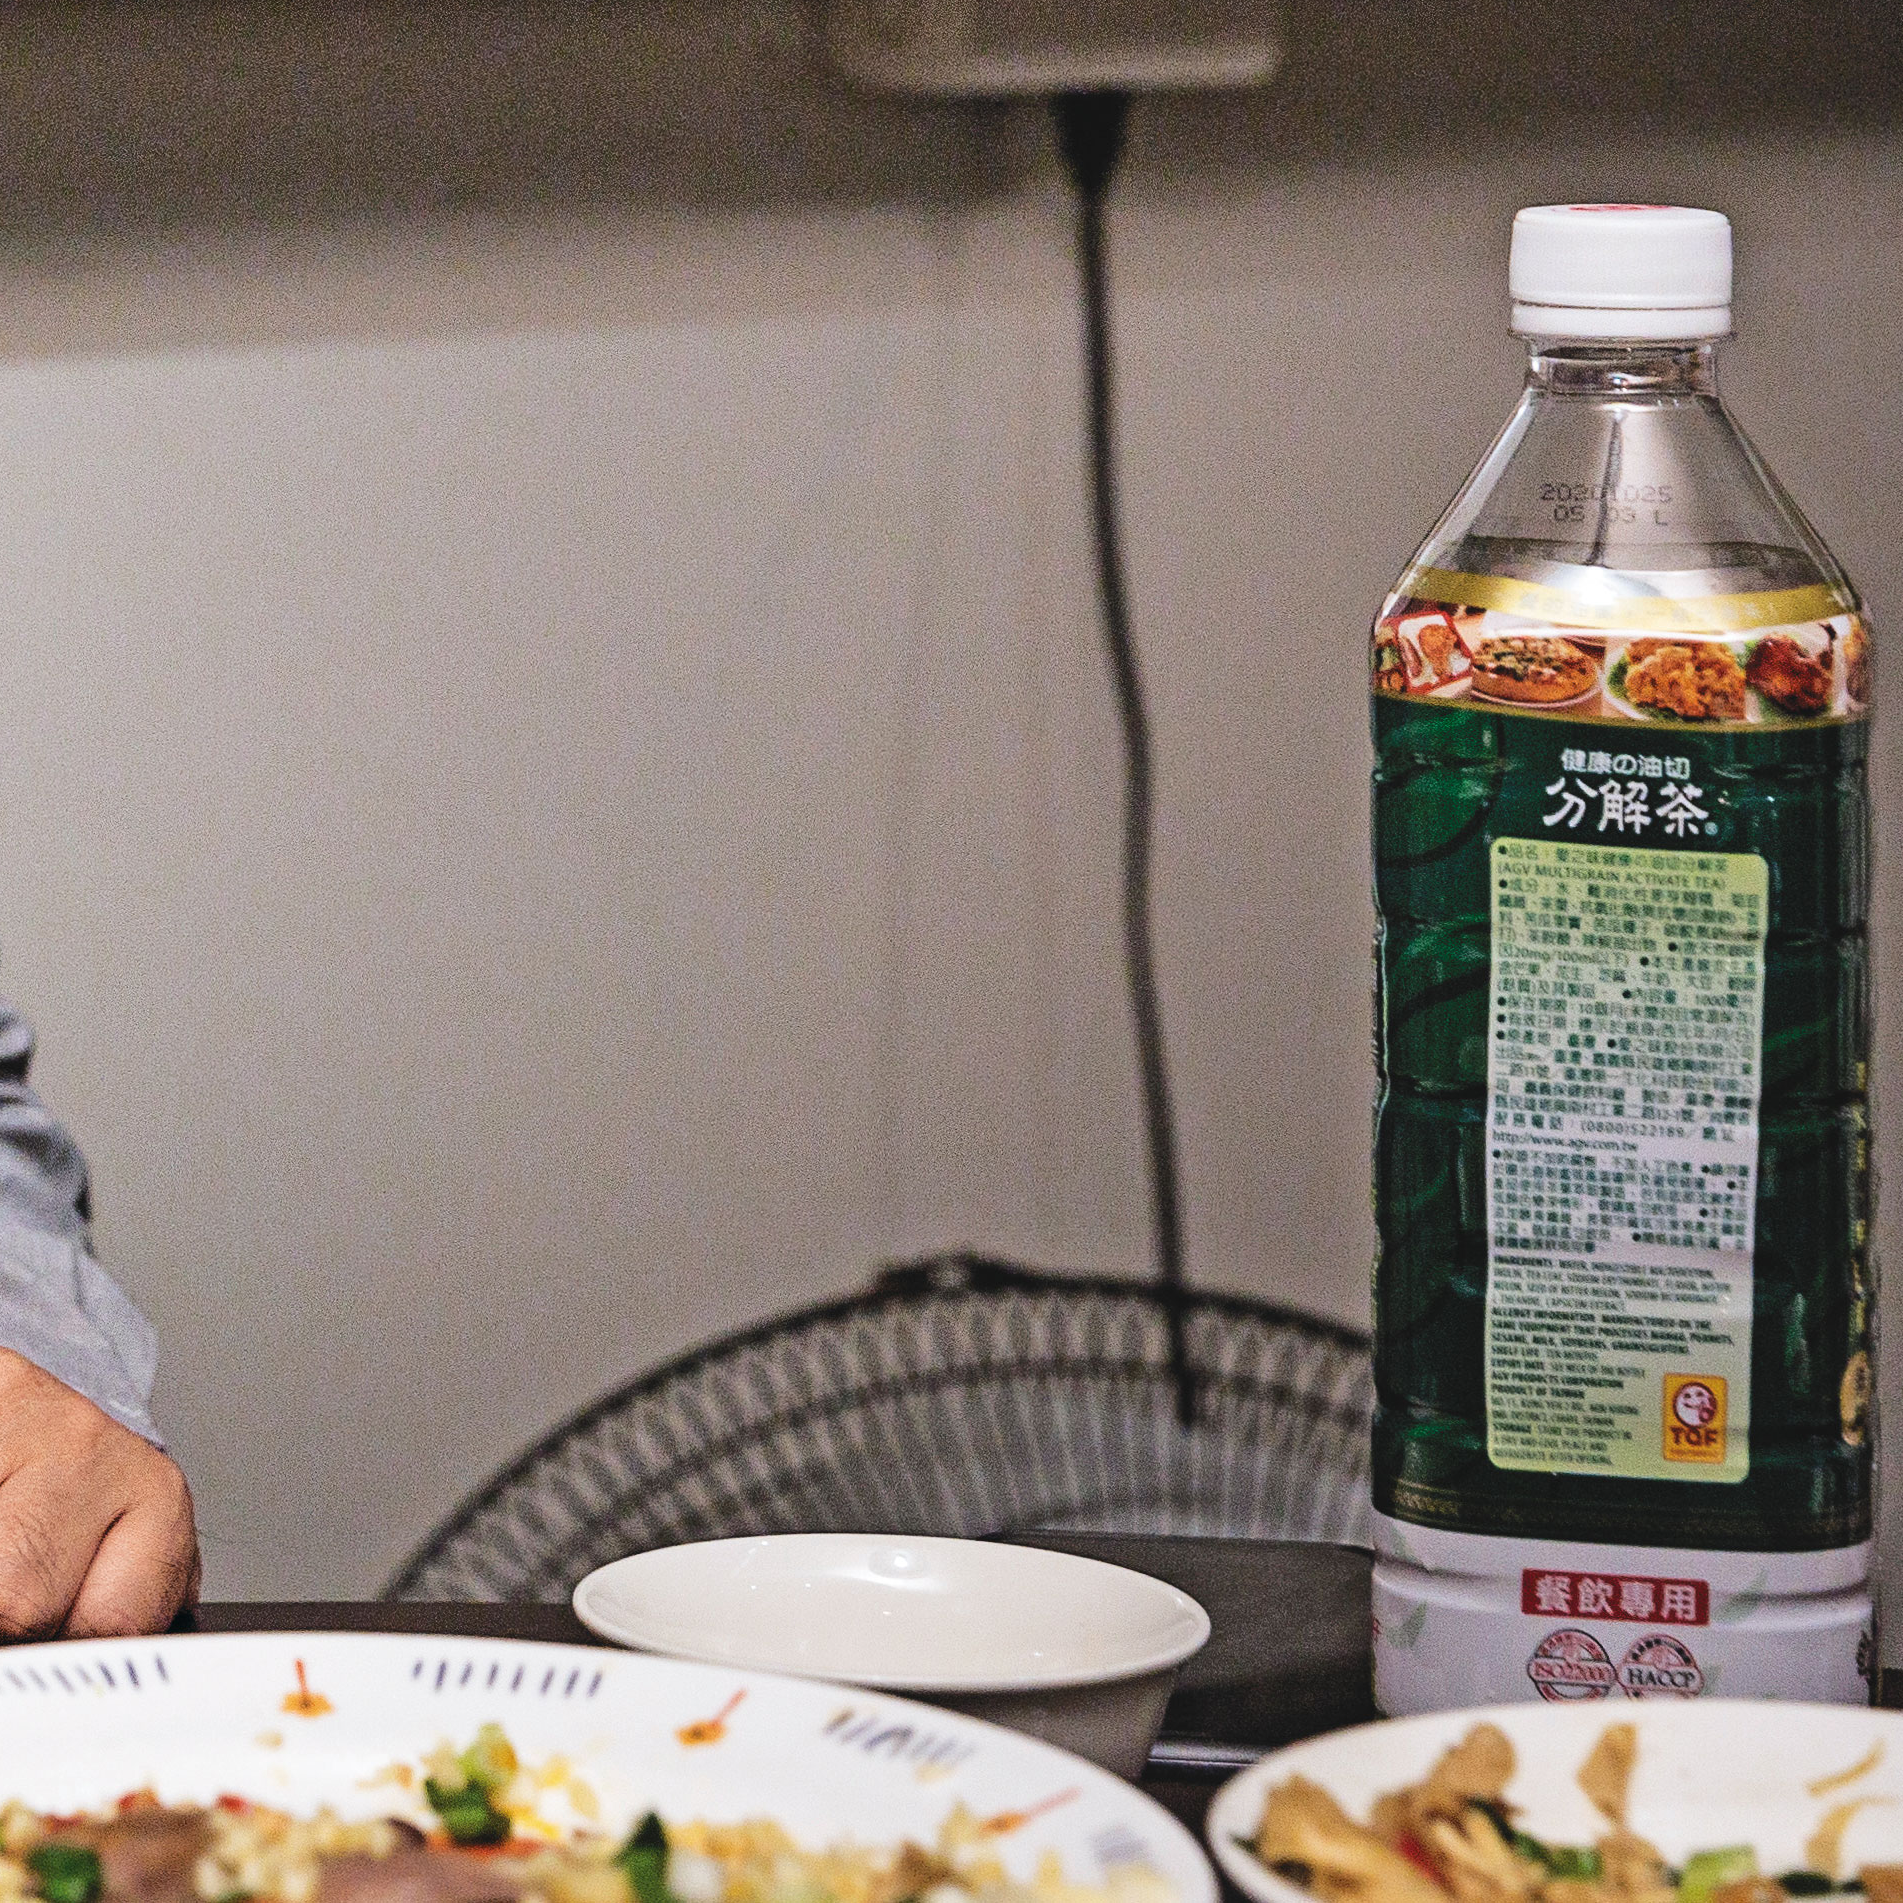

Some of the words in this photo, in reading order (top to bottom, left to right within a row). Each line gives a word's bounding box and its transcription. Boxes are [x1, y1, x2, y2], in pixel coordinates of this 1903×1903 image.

[1560, 747, 1691, 780] 健康の油切
[1542, 776, 1710, 837] 分解茶
[1670, 1426, 1719, 1448] TQF
[1535, 1574, 1697, 1621] 餐飲專用
[1626, 1666, 1696, 1688] HACCP
